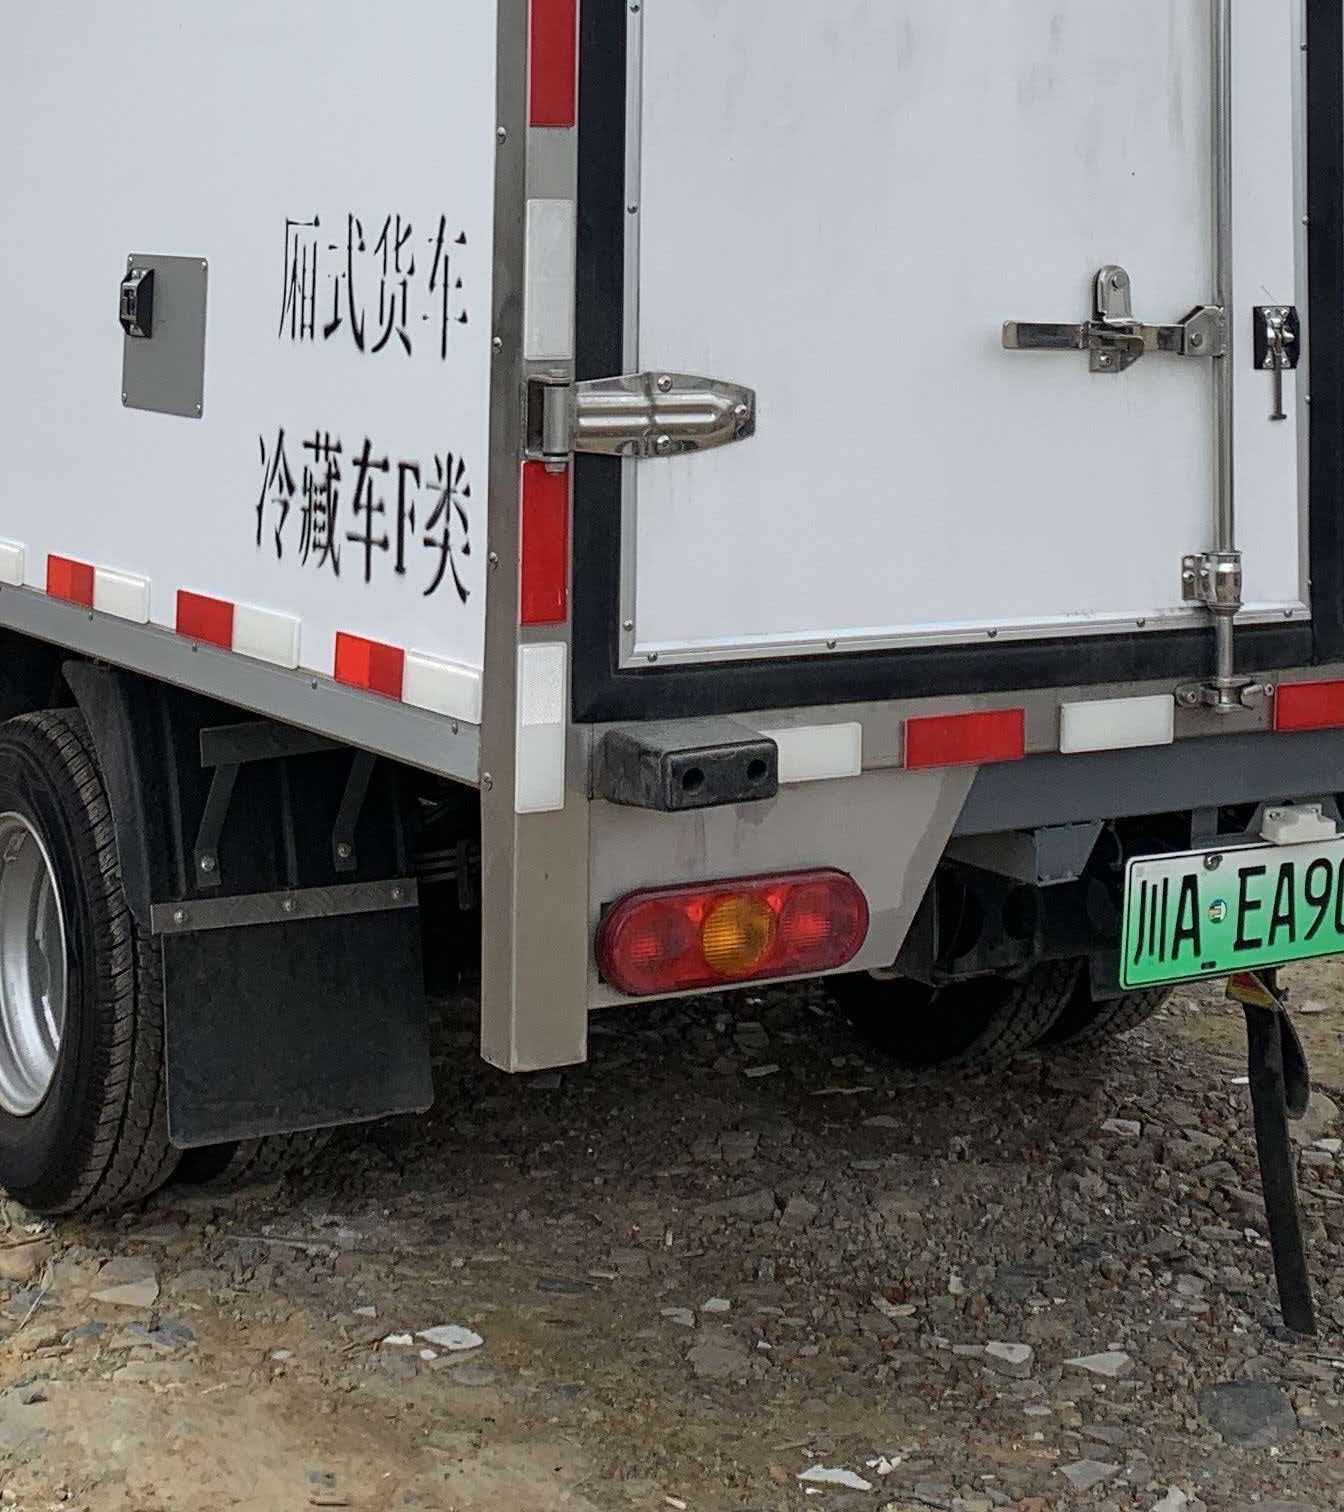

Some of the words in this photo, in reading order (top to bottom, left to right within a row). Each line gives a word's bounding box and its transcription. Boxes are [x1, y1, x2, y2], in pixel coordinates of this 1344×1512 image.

[278, 212, 469, 361] 厢式货车
[256, 427, 471, 604] 冷藏车F类
